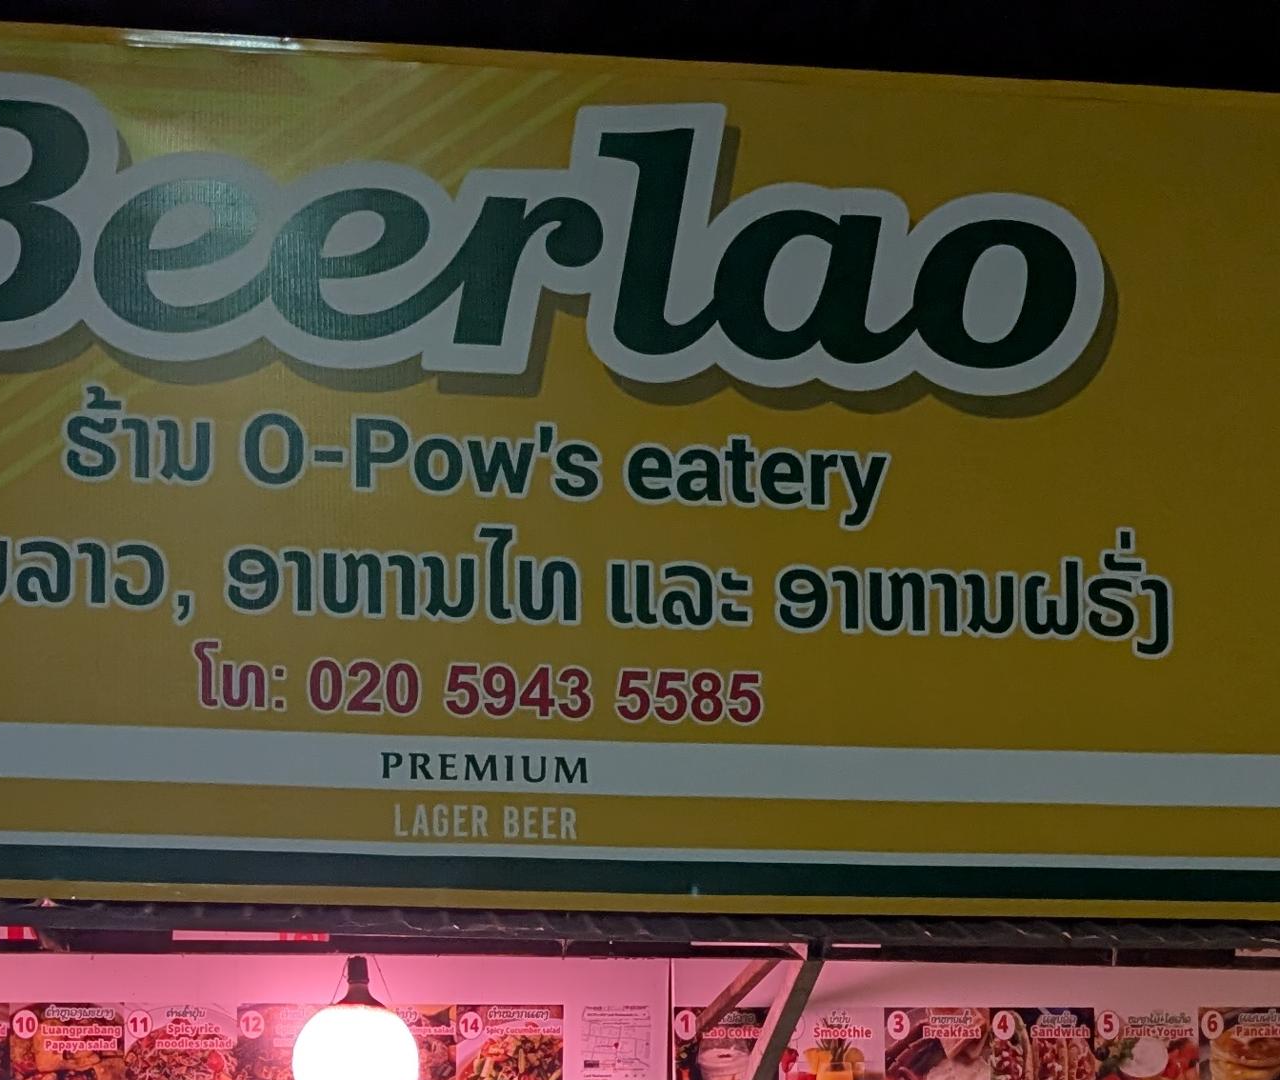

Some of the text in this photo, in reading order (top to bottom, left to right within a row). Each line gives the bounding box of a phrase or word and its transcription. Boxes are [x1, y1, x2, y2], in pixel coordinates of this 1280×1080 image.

[242, 412, 602, 499] O-Pow's
[626, 435, 890, 527] eatery
[307, 660, 421, 716] 020
[444, 663, 593, 720] 5943
[616, 670, 764, 725] 5585
[379, 750, 591, 786] PREMIUM
[393, 803, 579, 842] LAGER BEER
[15, 1016, 36, 1034] 10
[129, 1016, 149, 1033] 11
[167, 1022, 221, 1036] Spicy rice
[241, 1016, 262, 1033] 12
[460, 1018, 480, 1033] 14
[486, 1025, 561, 1036] Spicy Cucumber salad
[680, 1013, 691, 1033] 1
[813, 1025, 872, 1038] Smoothie
[893, 1013, 904, 1033] 3
[923, 1025, 982, 1038] Breakfast
[996, 1013, 1009, 1033] 4
[1030, 1025, 1091, 1038] Sandwich
[1102, 1013, 1114, 1033] 5
[1206, 1013, 1218, 1033] 6
[42, 1025, 122, 1039] Luangprabang
[45, 1038, 117, 1052] Papaya salad
[156, 1037, 232, 1049] noodles salad
